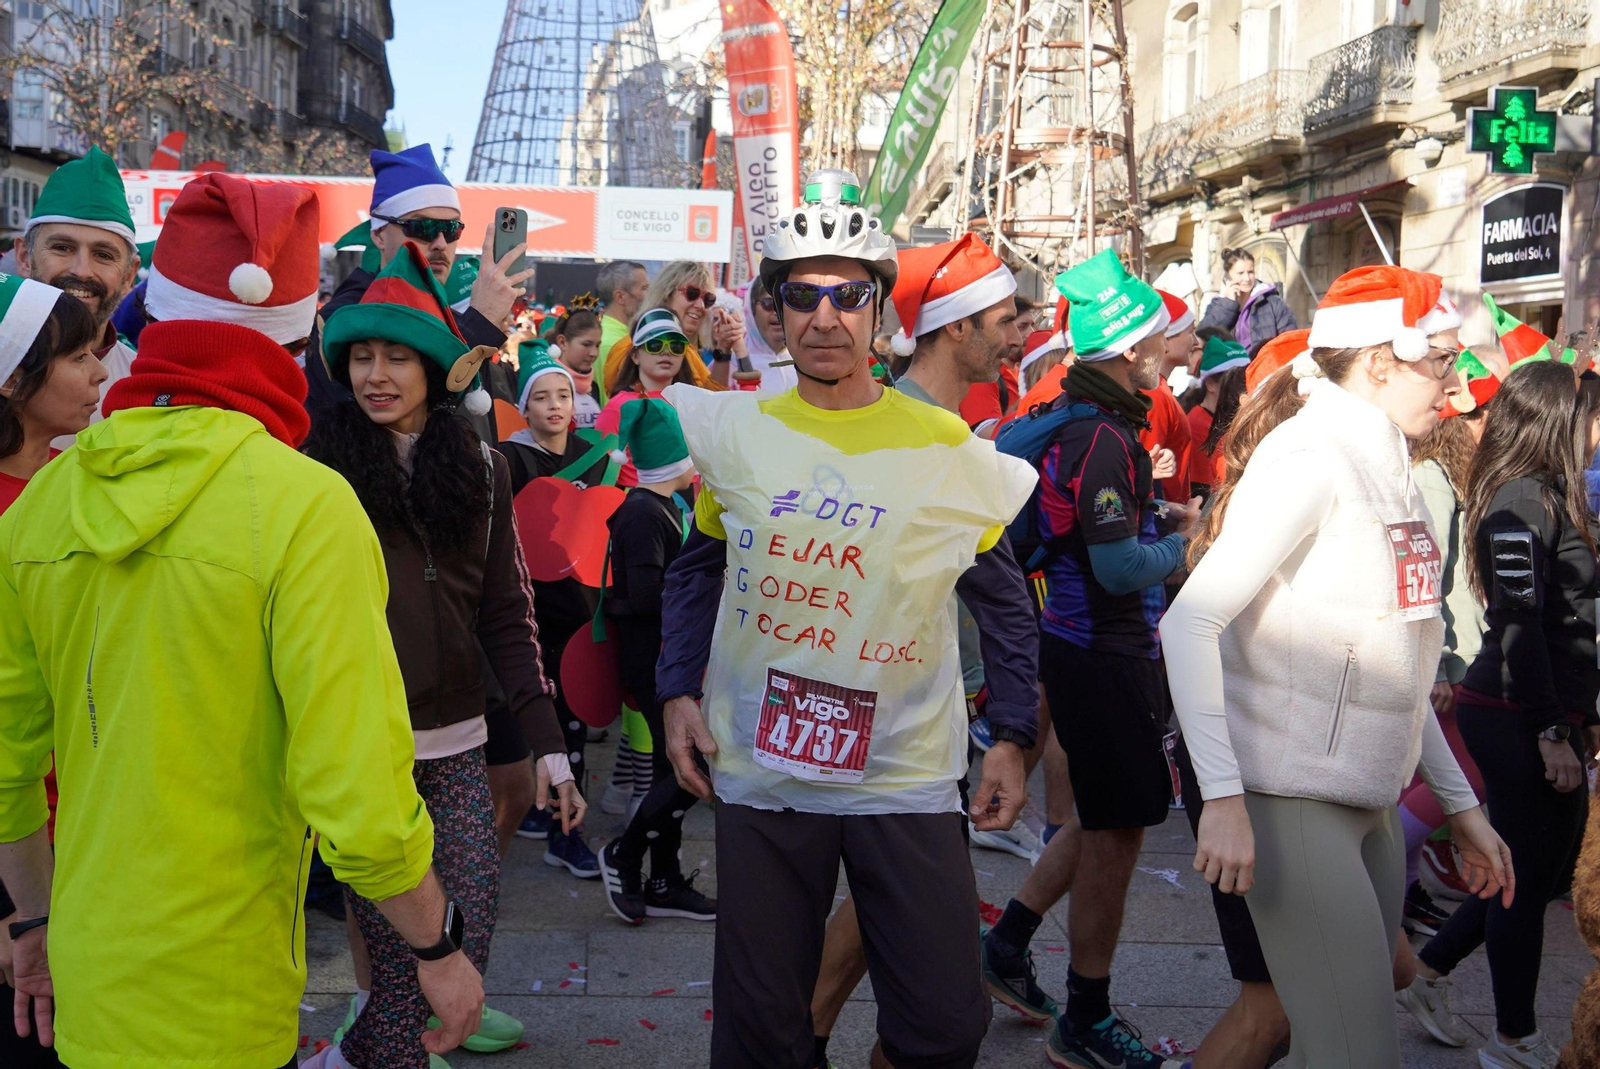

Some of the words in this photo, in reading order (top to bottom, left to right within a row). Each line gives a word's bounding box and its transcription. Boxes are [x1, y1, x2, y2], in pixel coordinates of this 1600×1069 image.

[1490, 119, 1549, 144] Feliz
[616, 209, 680, 222] CONCELLO
[624, 221, 641, 232] DE
[648, 222, 672, 233] VIGO
[1483, 212, 1558, 245] FARMACIA
[1487, 250, 1513, 266] Puerta
[1514, 248, 1528, 261] del
[1545, 247, 1551, 260] 4
[816, 498, 887, 529] DGT
[739, 528, 754, 550] D
[768, 533, 865, 580] EJAR
[1409, 539, 1433, 558] vigo
[737, 567, 749, 593] G
[760, 575, 853, 618] ODER
[736, 608, 749, 629] T
[757, 613, 835, 654] OCAR
[794, 695, 850, 721] vigo
[806, 692, 846, 707] SILVESTRE
[768, 713, 859, 765] 4737
